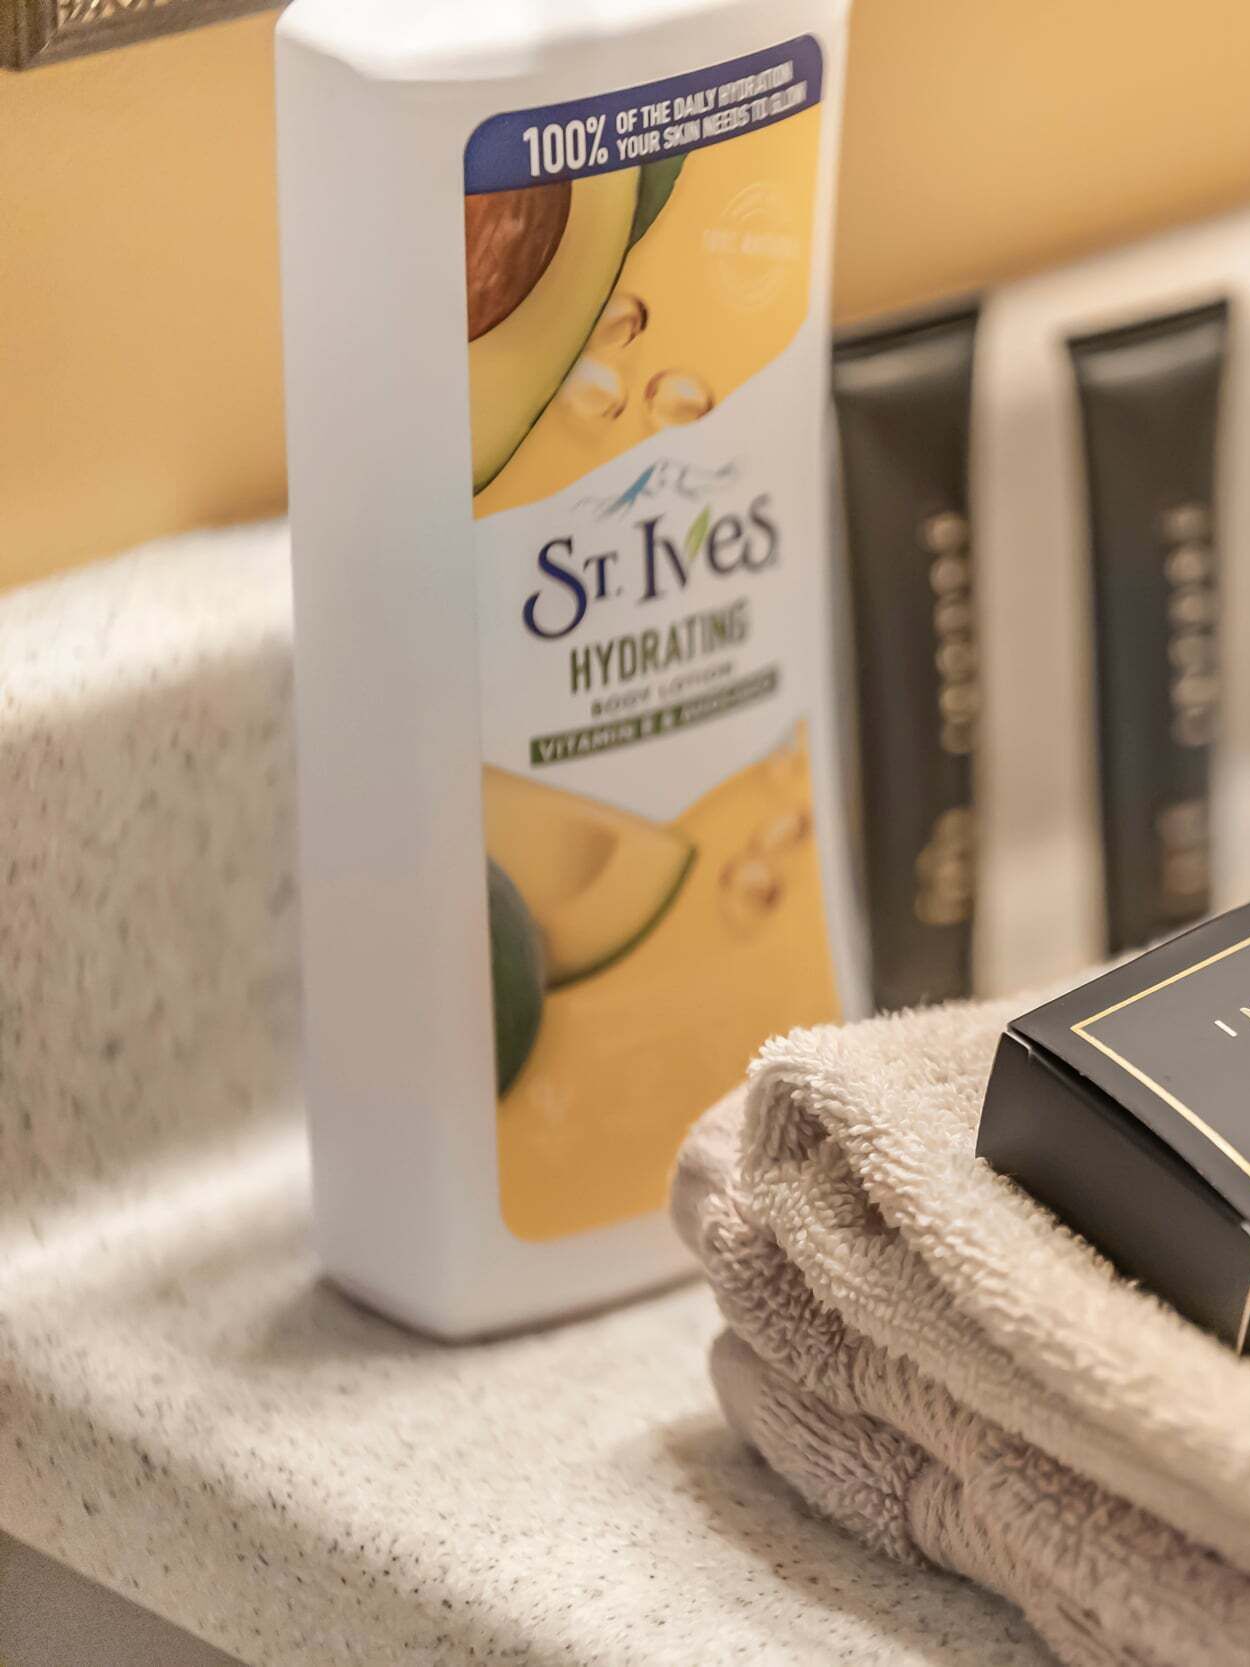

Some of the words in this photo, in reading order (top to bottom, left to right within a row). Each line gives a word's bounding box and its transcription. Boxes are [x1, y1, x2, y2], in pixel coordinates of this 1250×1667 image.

[616, 108, 638, 134] OF
[640, 100, 671, 128] THE
[673, 88, 717, 121] DAILY
[718, 60, 794, 108] HYDRATION
[617, 130, 660, 160] YOUR
[663, 118, 700, 150] SKIN
[702, 103, 751, 138] NEEDS
[752, 97, 769, 122] TO
[523, 115, 608, 177] 100%
[569, 598, 748, 694] HYDRATING
